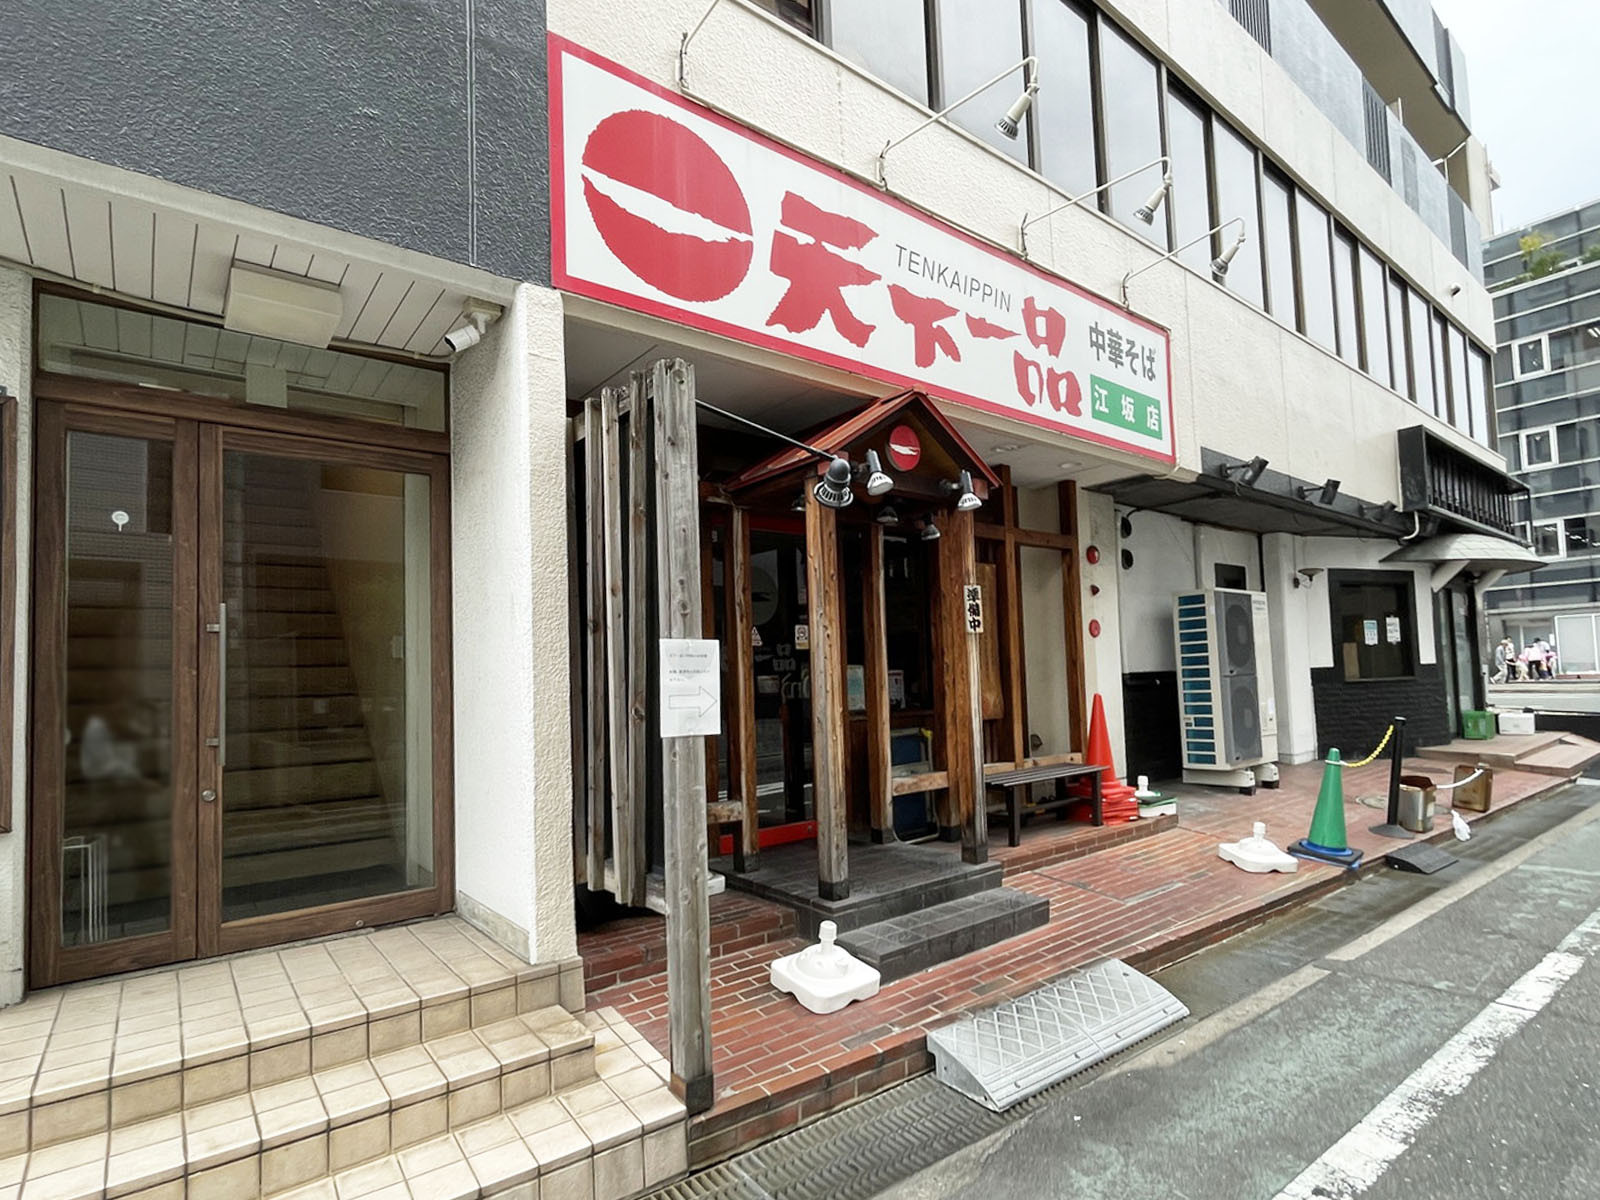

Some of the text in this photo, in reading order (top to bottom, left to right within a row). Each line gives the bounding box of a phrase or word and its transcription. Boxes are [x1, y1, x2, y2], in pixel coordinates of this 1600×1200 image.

[765, 190, 1082, 417] 天下一品
[895, 244, 1011, 313] TENKAIPPIN
[1089, 321, 1156, 382] 中華そば
[1094, 384, 1161, 432] 江坂店
